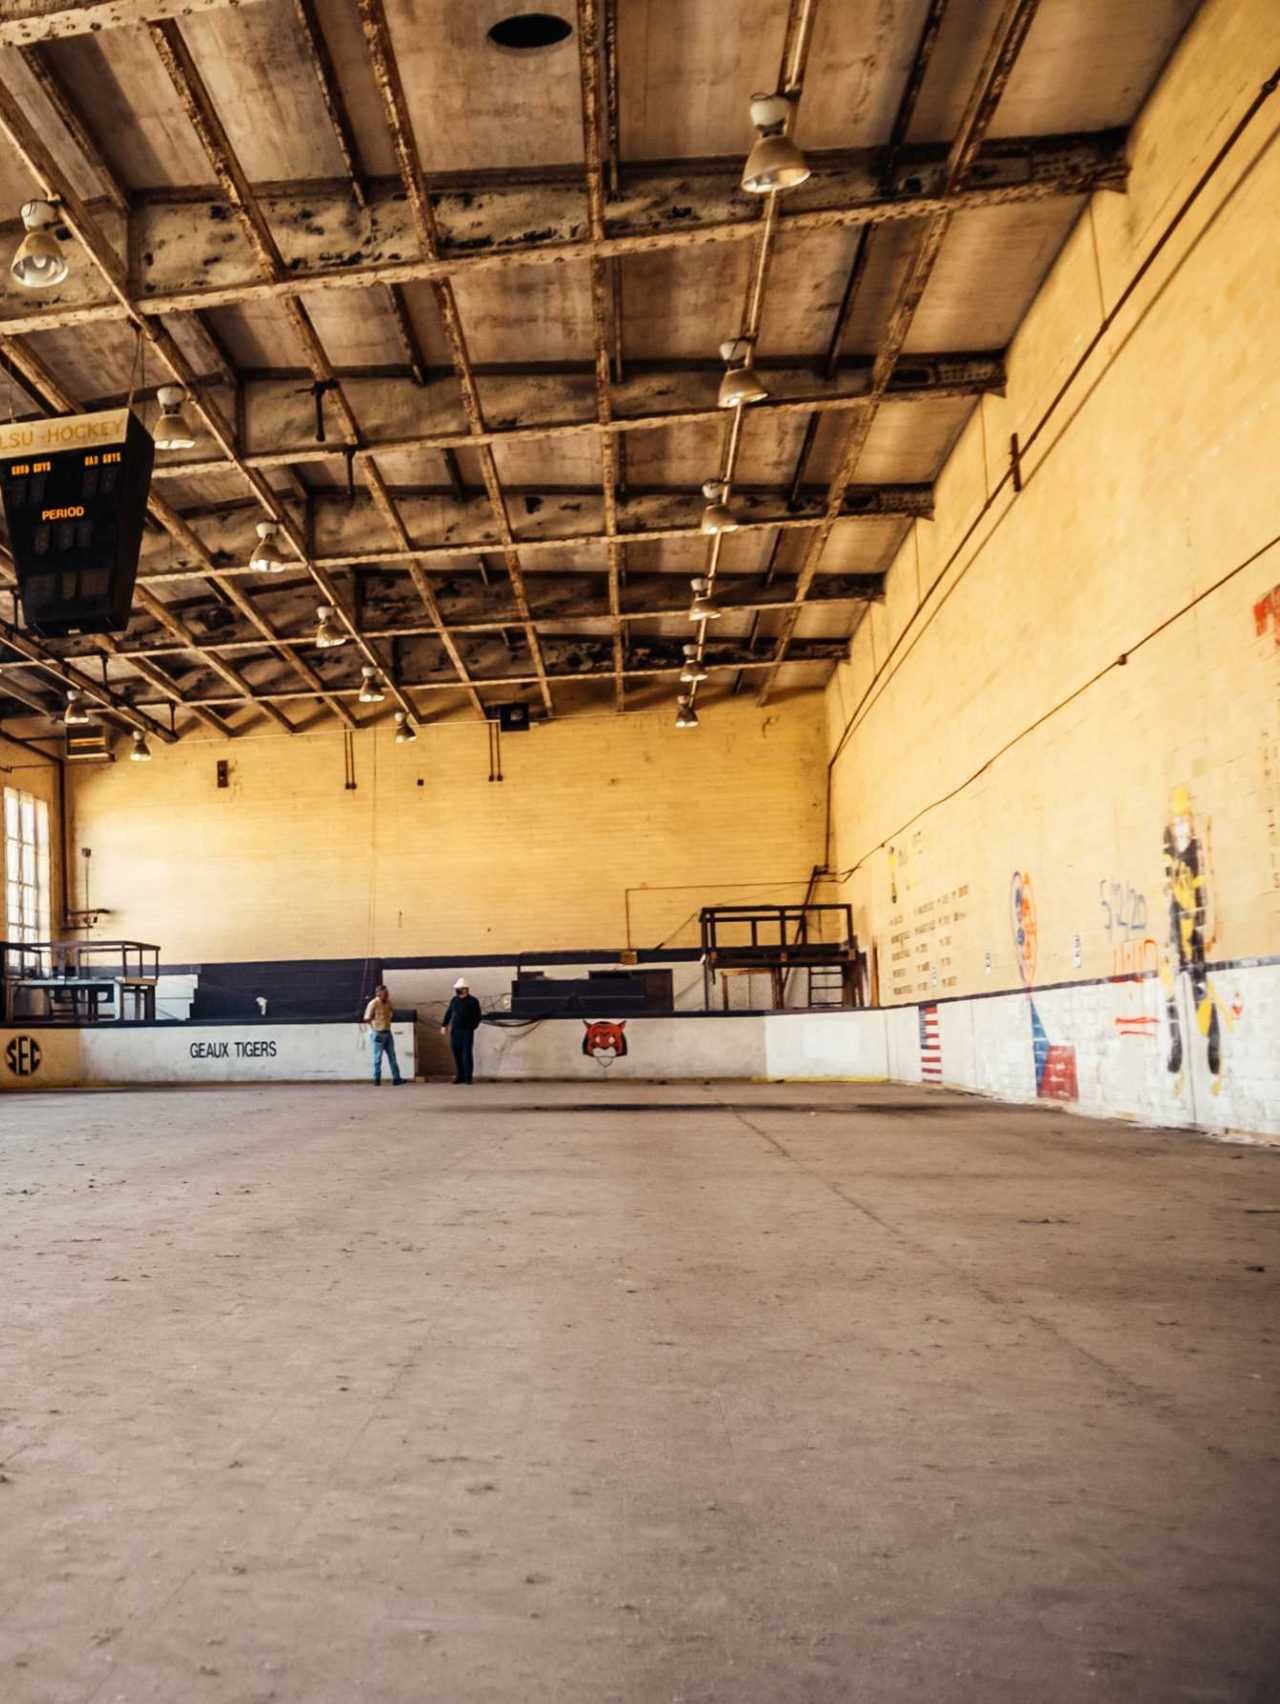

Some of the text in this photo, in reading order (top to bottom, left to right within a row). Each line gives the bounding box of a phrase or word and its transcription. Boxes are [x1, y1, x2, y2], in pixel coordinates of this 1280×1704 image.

[0, 420, 123, 449] LSU HOCKEY
[42, 506, 85, 520] PERIOD
[6, 1036, 41, 1075] SEC
[190, 1040, 277, 1058] GEAUX TIGERS
